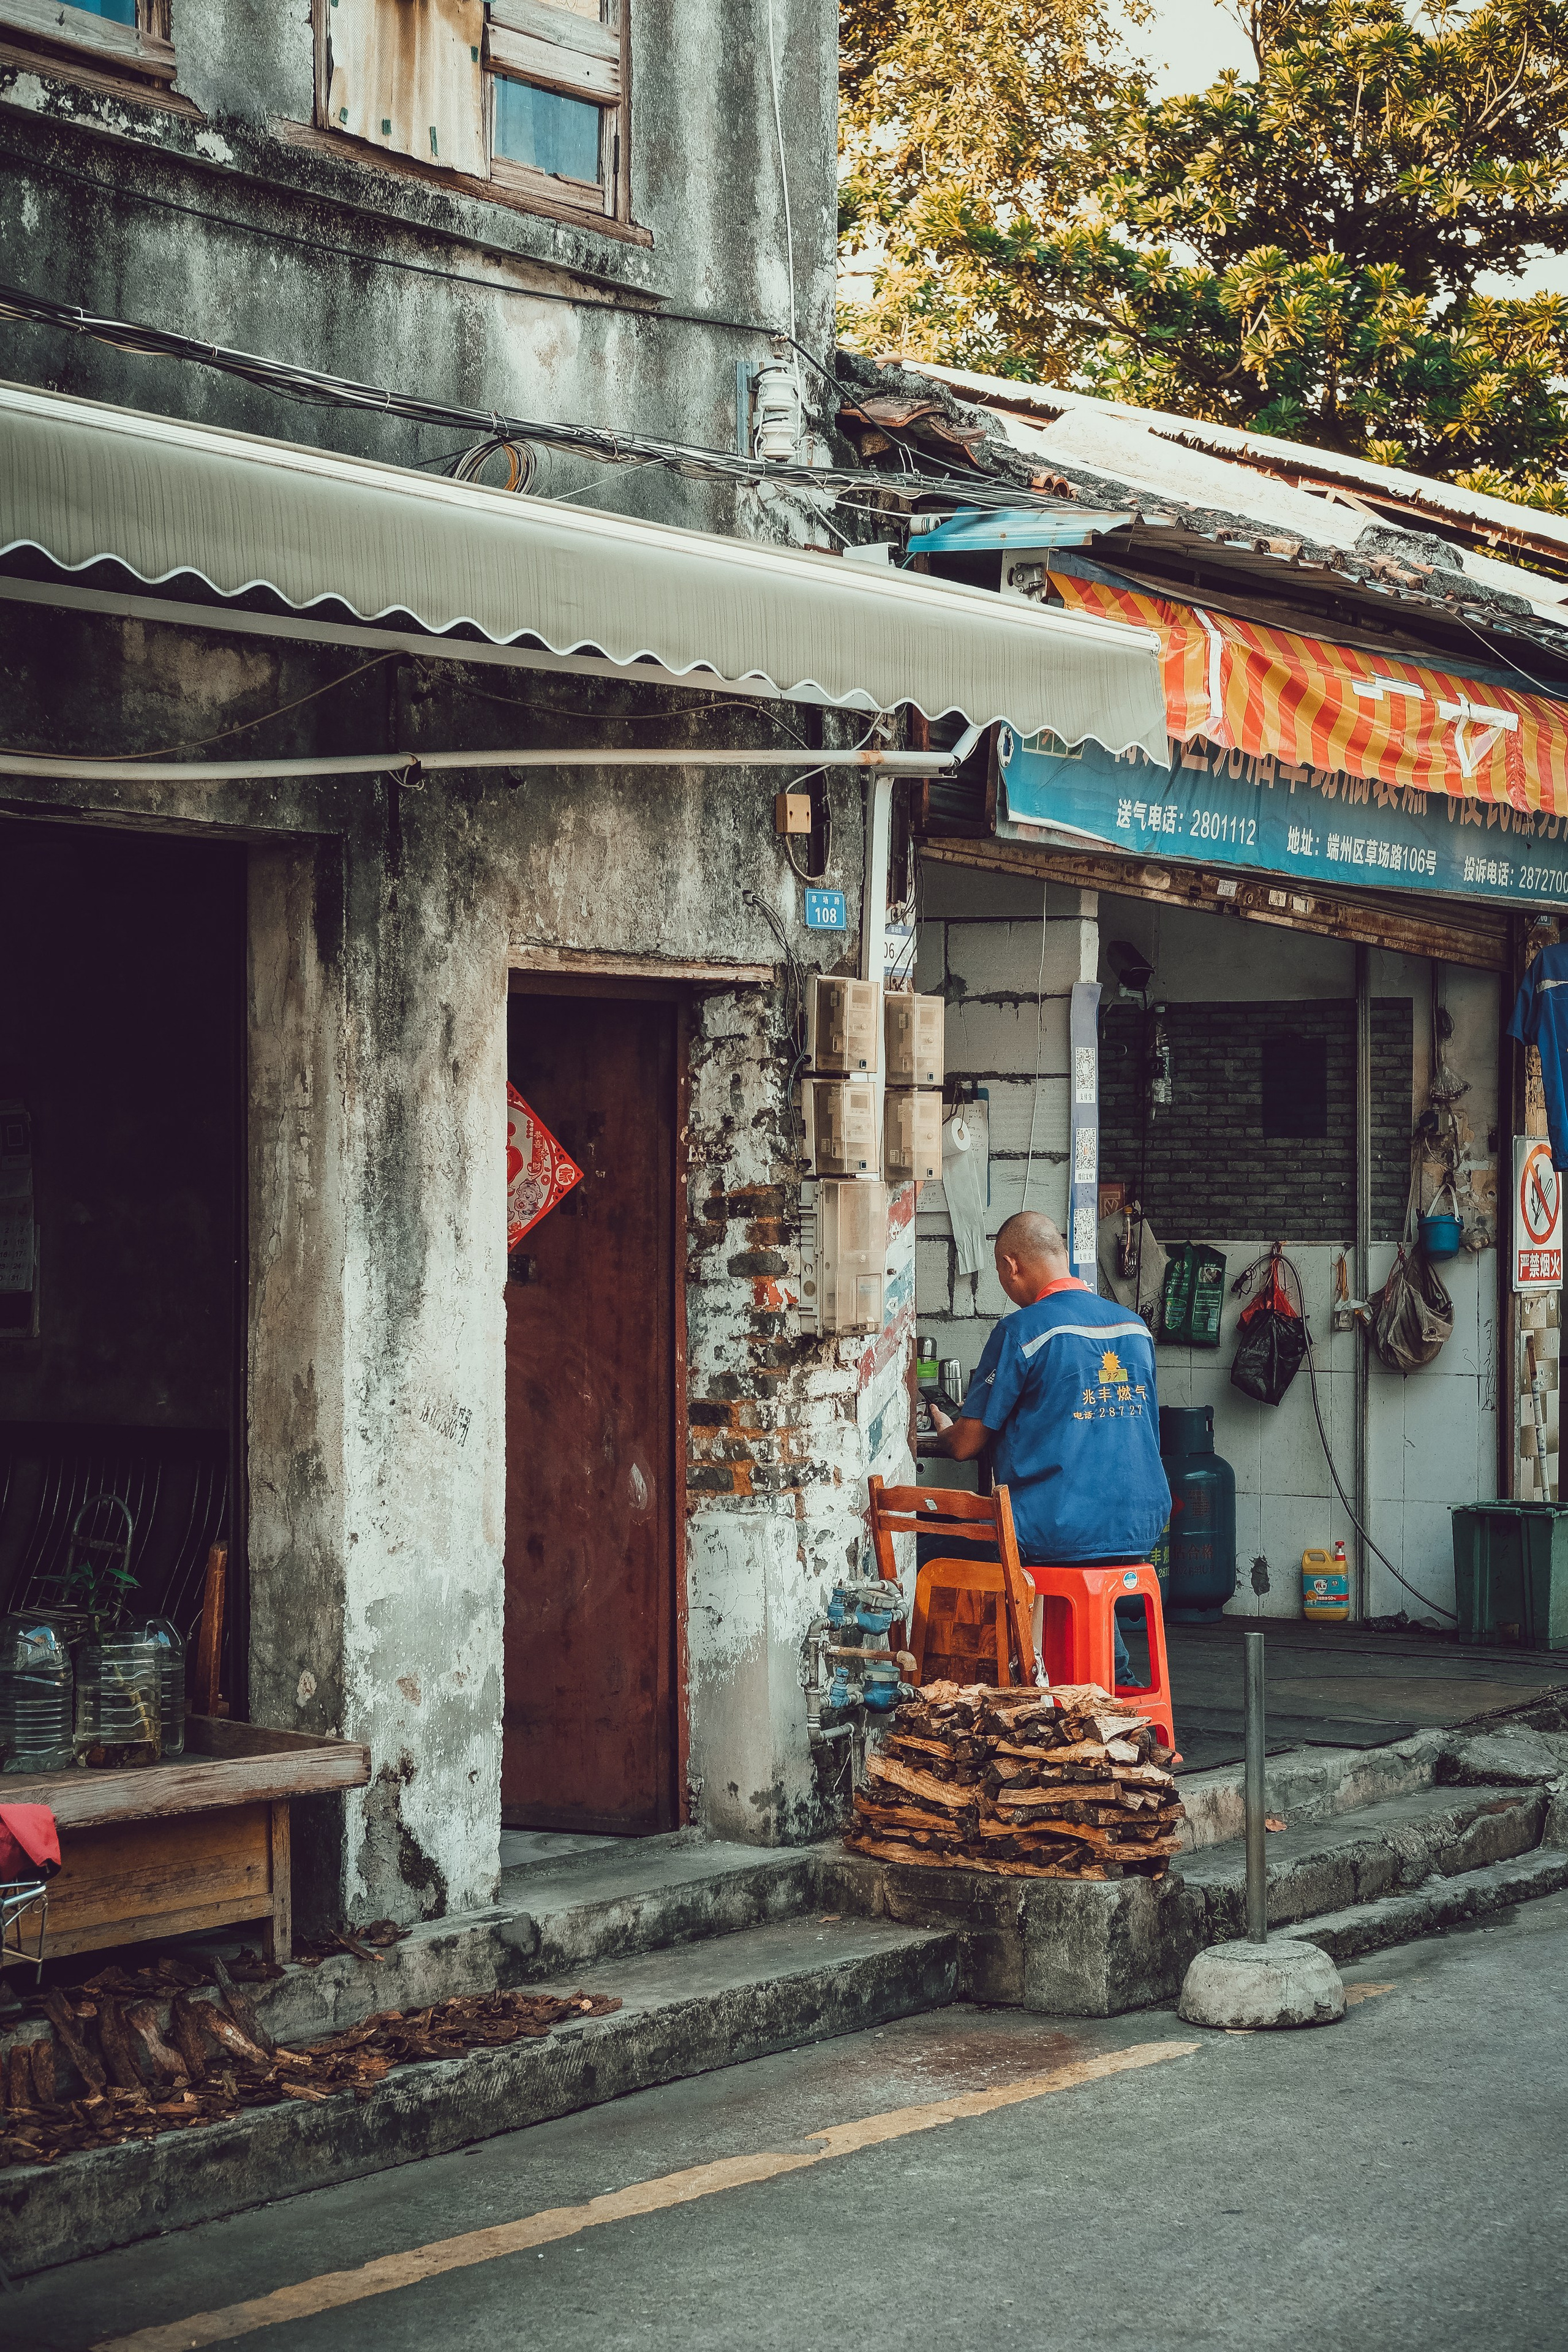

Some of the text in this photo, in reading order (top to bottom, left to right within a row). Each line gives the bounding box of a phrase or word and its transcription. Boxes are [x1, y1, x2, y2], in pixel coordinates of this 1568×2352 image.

[815, 907, 837, 924] 108
[532, 1130, 549, 1171] 恭喜發財
[1519, 1253, 1561, 1278] 严禁烟火
[1082, 1384, 1147, 1405] 兆丰燃气
